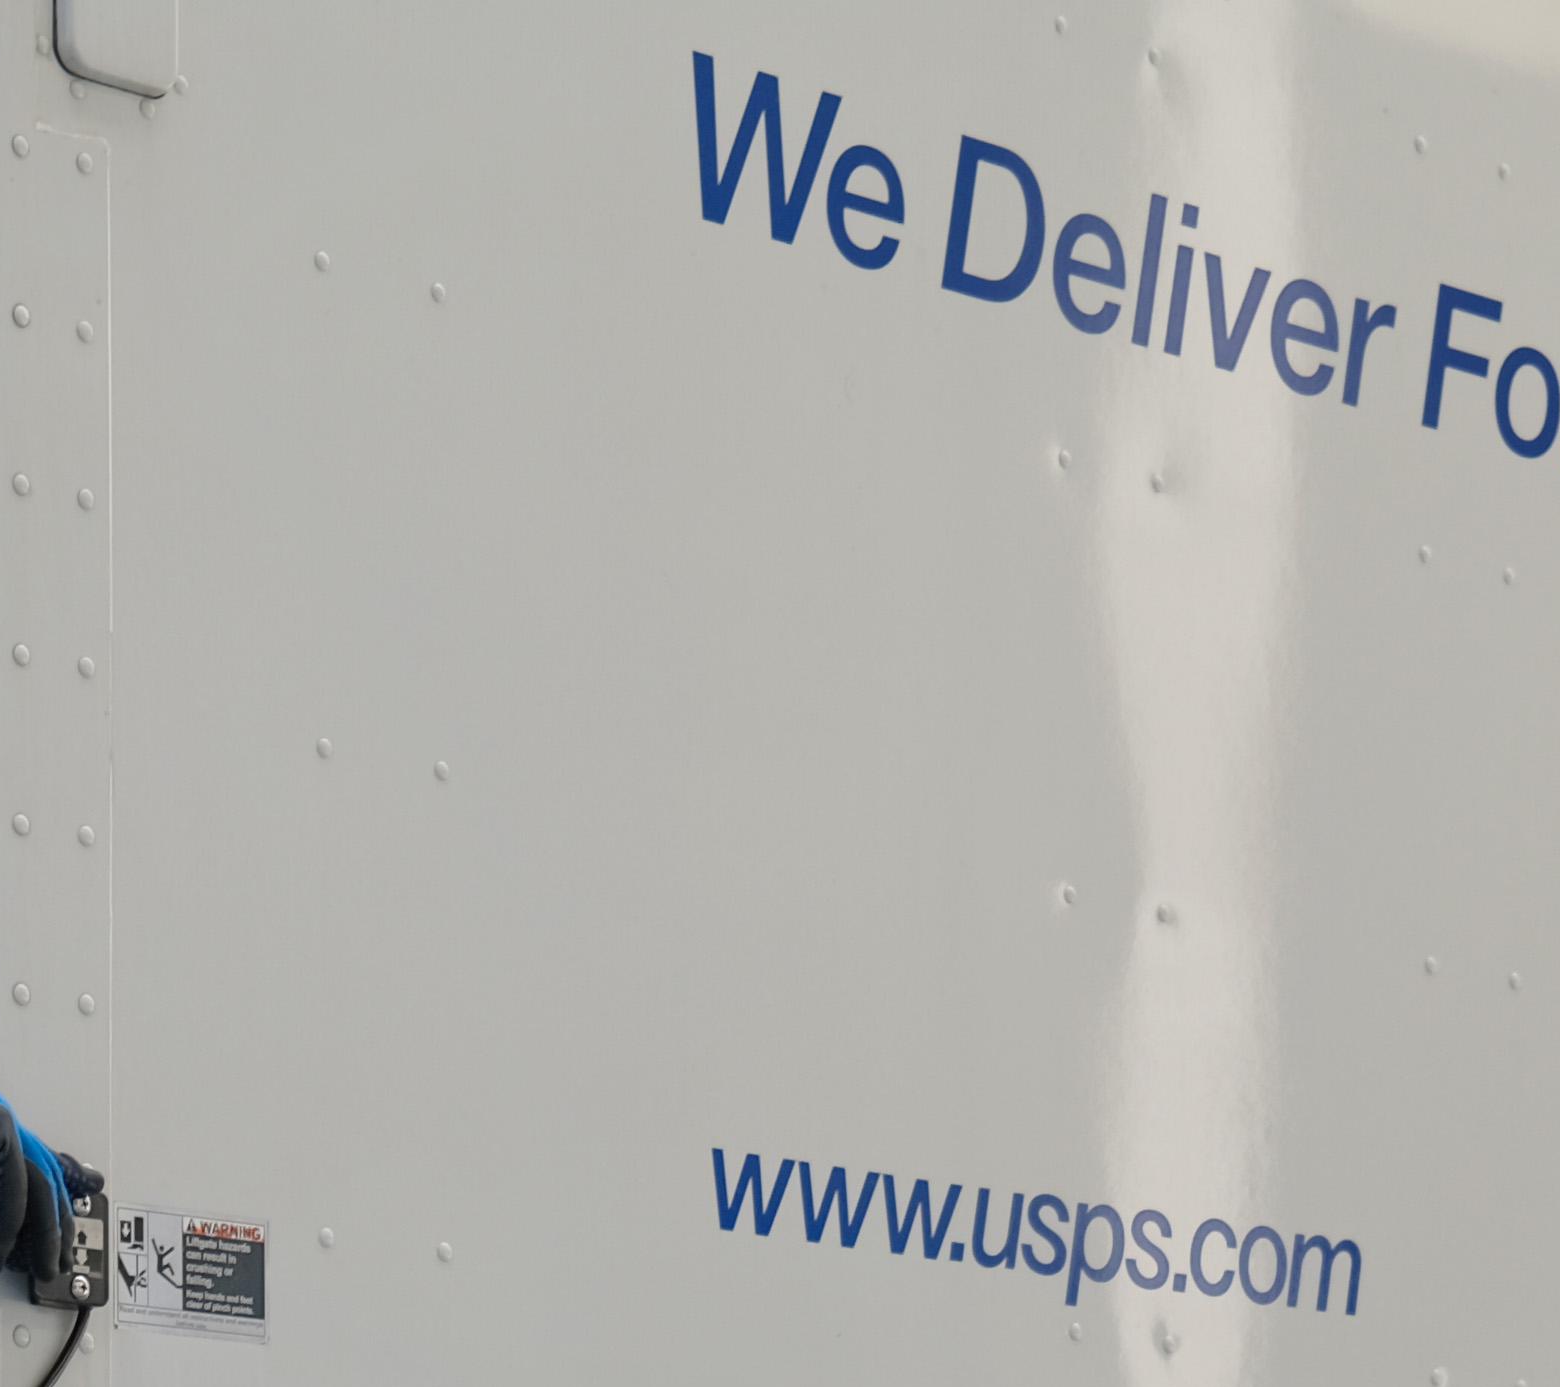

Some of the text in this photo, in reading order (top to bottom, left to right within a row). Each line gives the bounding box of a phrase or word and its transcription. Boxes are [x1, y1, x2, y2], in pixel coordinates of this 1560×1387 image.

[691, 50, 907, 271] We
[940, 134, 1396, 407] Deliver
[199, 1220, 261, 1241] WARNING
[203, 1252, 227, 1264] result
[711, 1147, 1364, 1316] www.usps.com
